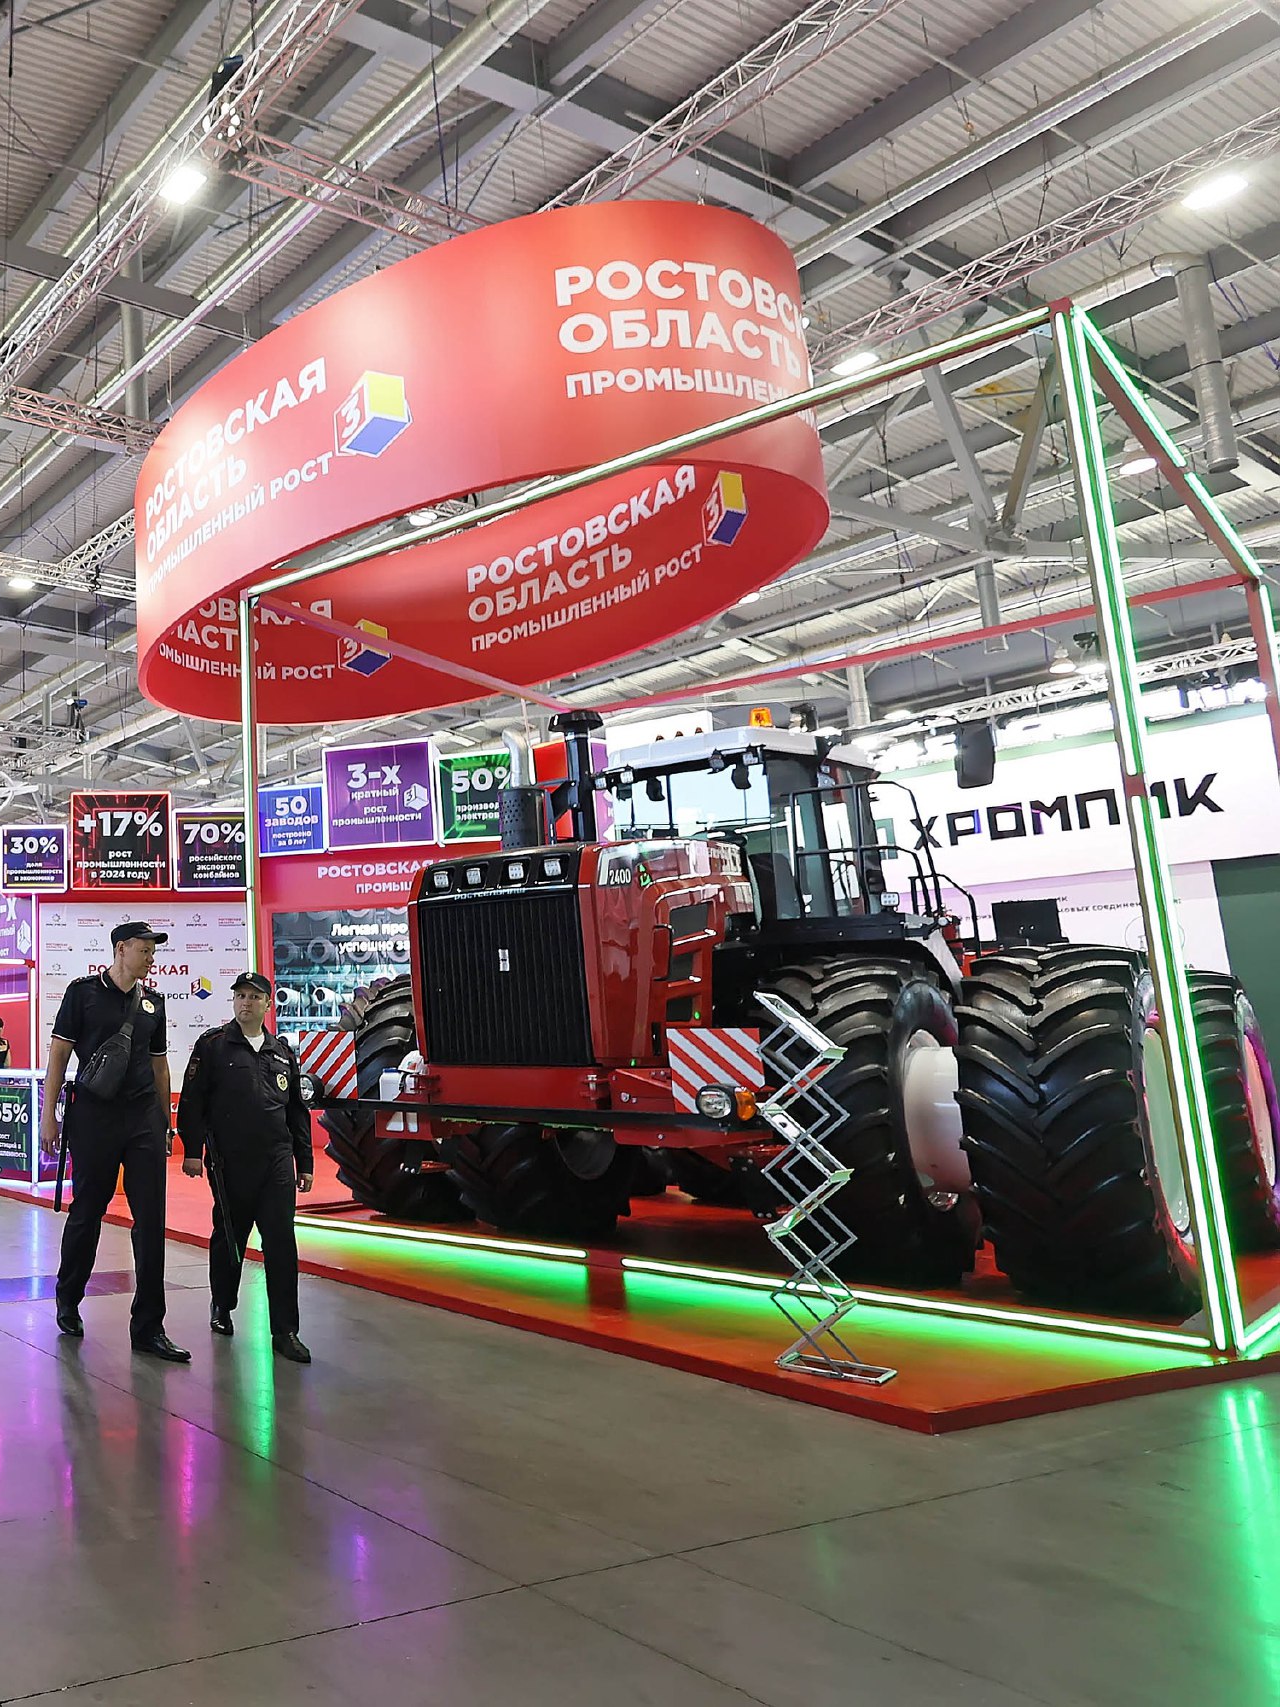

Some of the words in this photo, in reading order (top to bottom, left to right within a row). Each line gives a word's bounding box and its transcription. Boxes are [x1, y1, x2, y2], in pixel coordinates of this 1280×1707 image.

[555, 259, 804, 341] РОСТОВСК
[558, 309, 801, 379] ОБЛАСТЬ
[146, 357, 327, 529] РОСТОВСКАЯ
[147, 454, 247, 563] ОБЛАСТЬ
[148, 483, 265, 597] ПРОМЫШЛЕННЫЙ
[270, 451, 333, 500] РОСТ
[467, 465, 697, 593] РОСТОВСКАЯ
[468, 543, 632, 623] ОБЛАСТЬ
[472, 569, 650, 652] ПРОМЫШЛЕННЫЙ
[654, 543, 703, 585] РОСТ
[282, 664, 336, 680] РОСТ
[351, 788, 399, 800] кратный
[276, 795, 308, 816] 50
[363, 804, 388, 814] рост
[455, 801, 500, 813] производ
[78, 811, 164, 837] +17%
[264, 815, 319, 828] заводов
[332, 812, 422, 827] промышленности
[183, 822, 245, 845] 70%
[272, 830, 312, 839] построено
[10, 837, 59, 854] 30%
[108, 851, 133, 860] рост
[188, 853, 243, 863] российского
[76, 860, 166, 869] промышленности
[196, 863, 236, 872] экспорта
[100, 870, 126, 878] 2024
[126, 871, 151, 880] году
[193, 870, 240, 879] комбайнов
[609, 869, 632, 885] 2400
[331, 923, 379, 936] Легкая
[338, 940, 392, 954] успешно
[88, 964, 189, 976] РОСКАЯ
